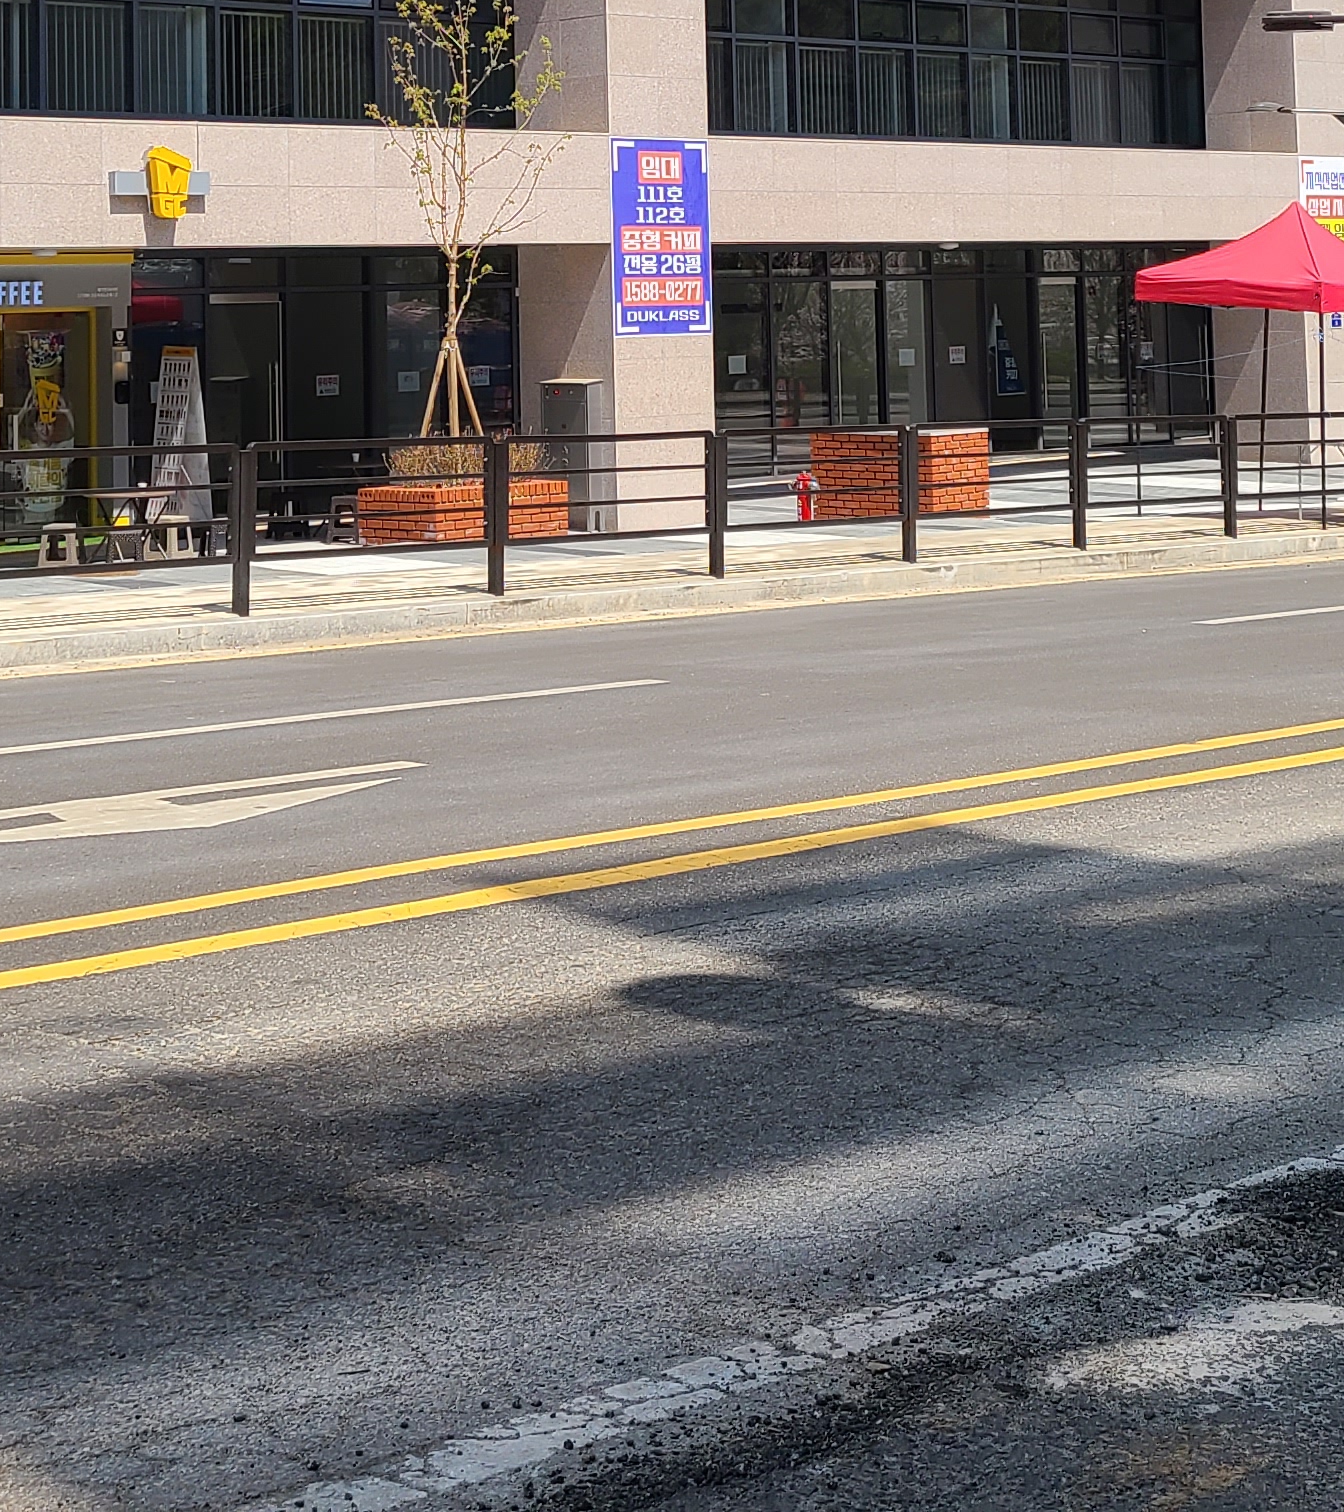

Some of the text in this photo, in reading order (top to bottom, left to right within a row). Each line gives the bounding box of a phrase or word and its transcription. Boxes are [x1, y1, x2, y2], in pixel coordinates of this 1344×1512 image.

[641, 156, 680, 179] 임대
[637, 186, 684, 203] 111호
[636, 207, 685, 223] 112호
[1308, 198, 1331, 216] 상업
[623, 231, 701, 251] 중형 커피
[623, 255, 702, 274] 전용 26평
[625, 281, 701, 302] 1588-0277
[627, 310, 700, 322] DUKLASS
